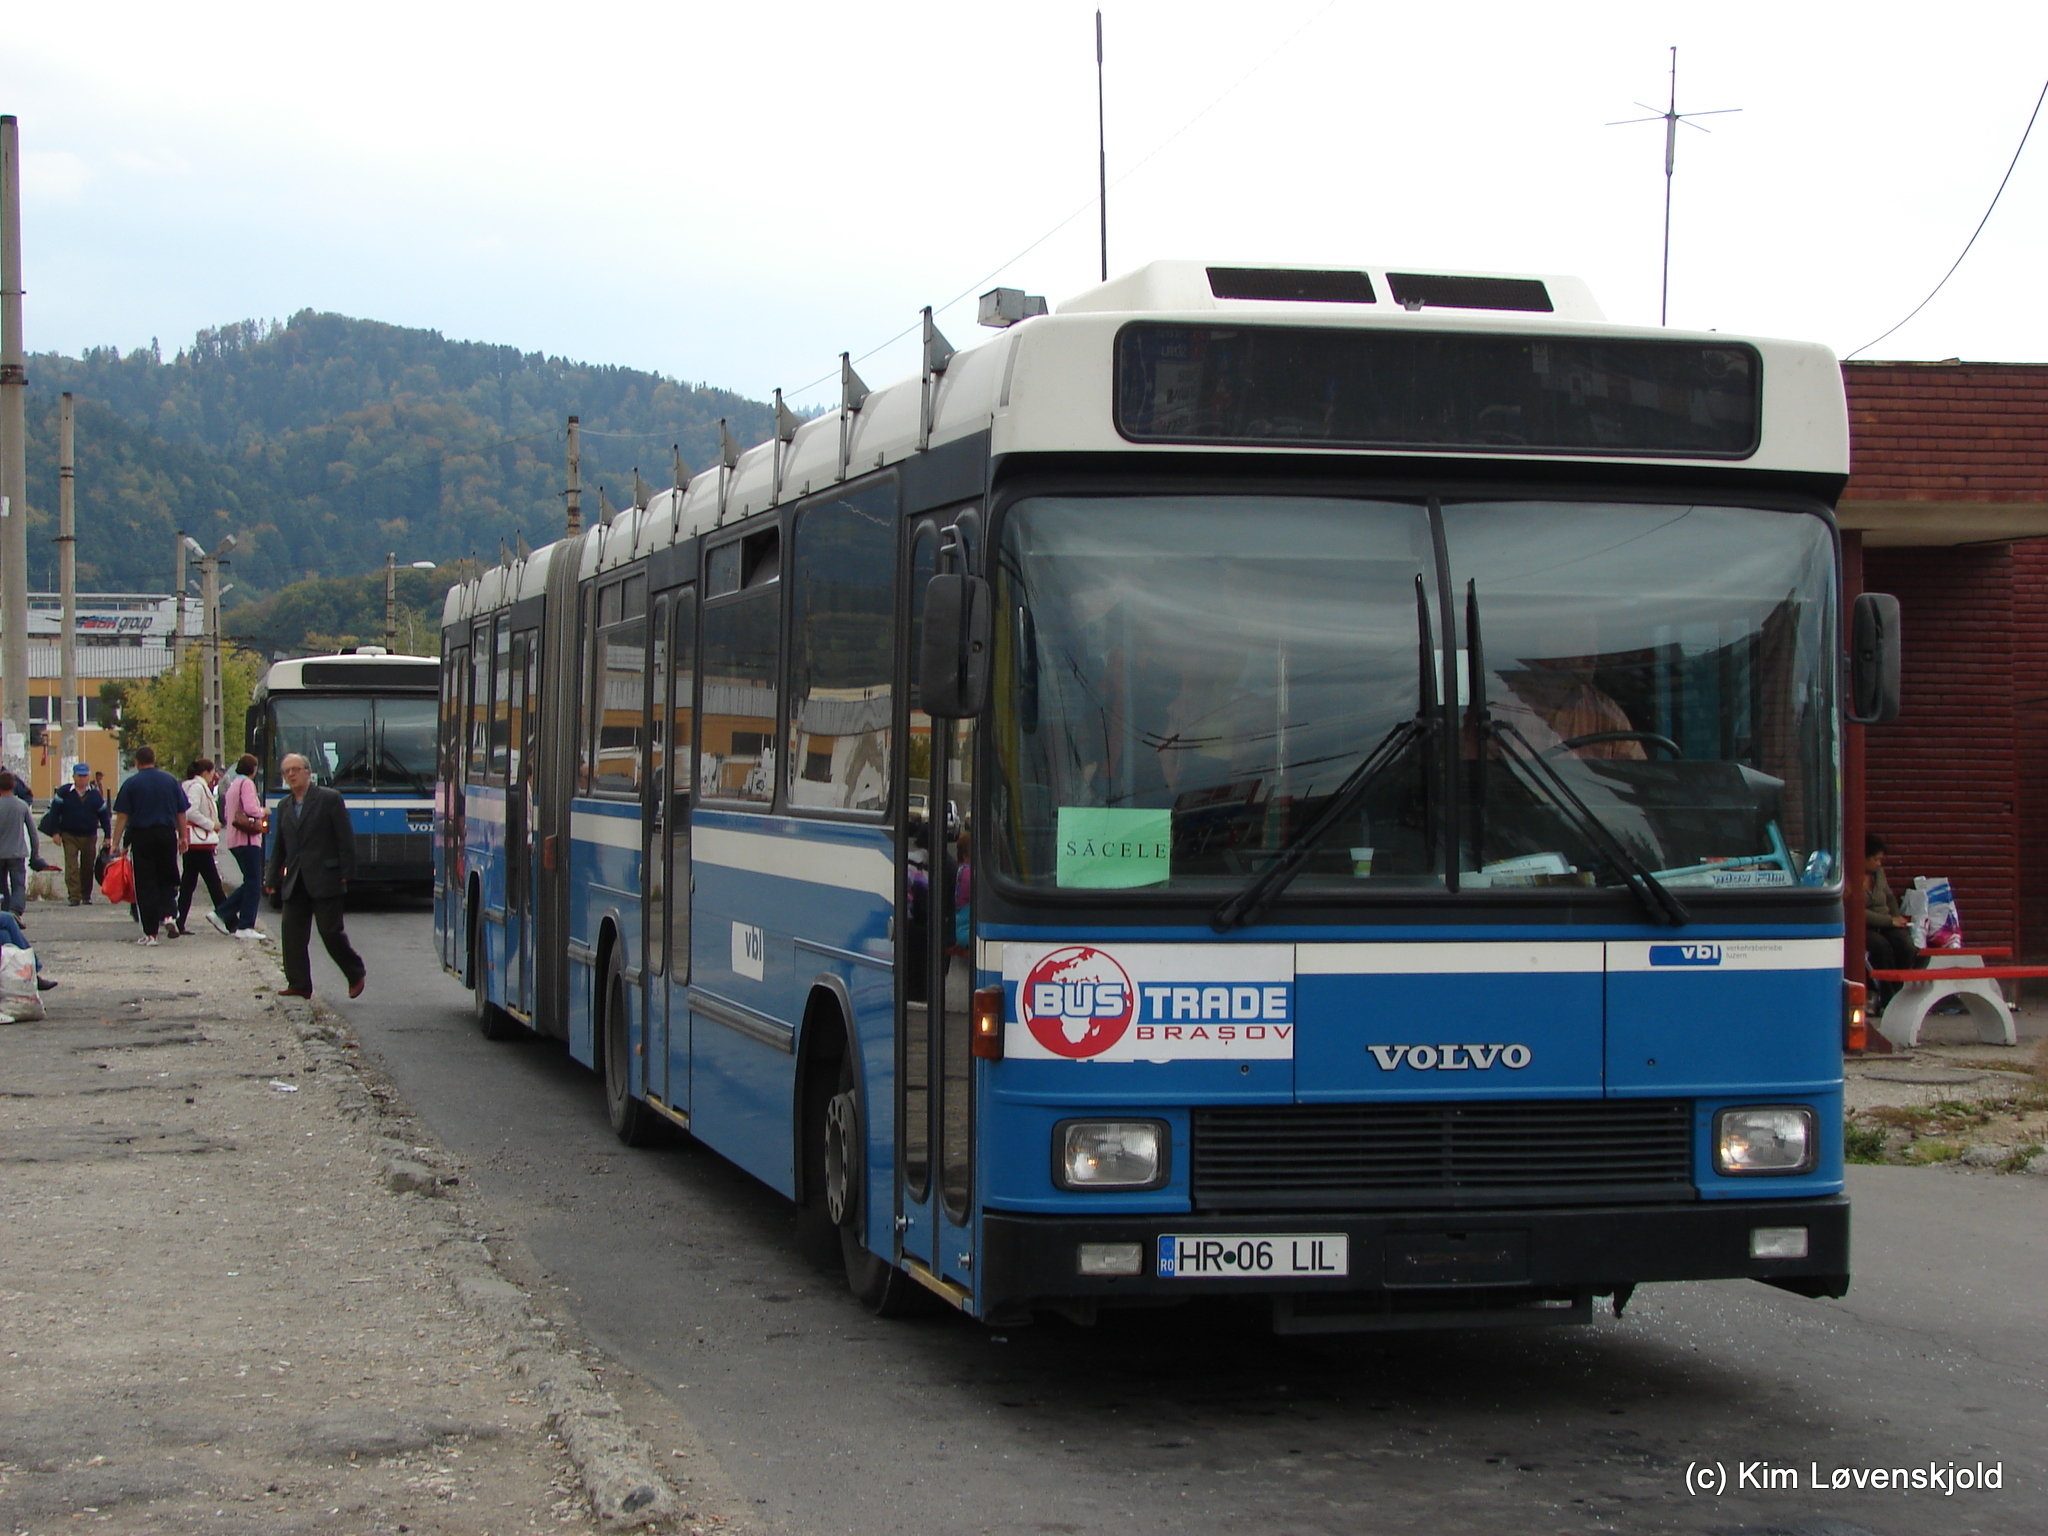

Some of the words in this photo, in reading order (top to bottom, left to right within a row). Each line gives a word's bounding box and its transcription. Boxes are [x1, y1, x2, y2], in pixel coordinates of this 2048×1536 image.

[117, 616, 153, 634] group
[1066, 838, 1167, 858] SĂCELE
[745, 926, 762, 962] vbl
[1681, 944, 1719, 960] vbl
[1725, 952, 1748, 960] luzern
[1033, 982, 1125, 1017] BUS
[1144, 986, 1288, 1020] TRADE
[1367, 1044, 1532, 1070] VOLVO
[1160, 1258, 1174, 1272] RO
[1292, 1240, 1336, 1271] LIL
